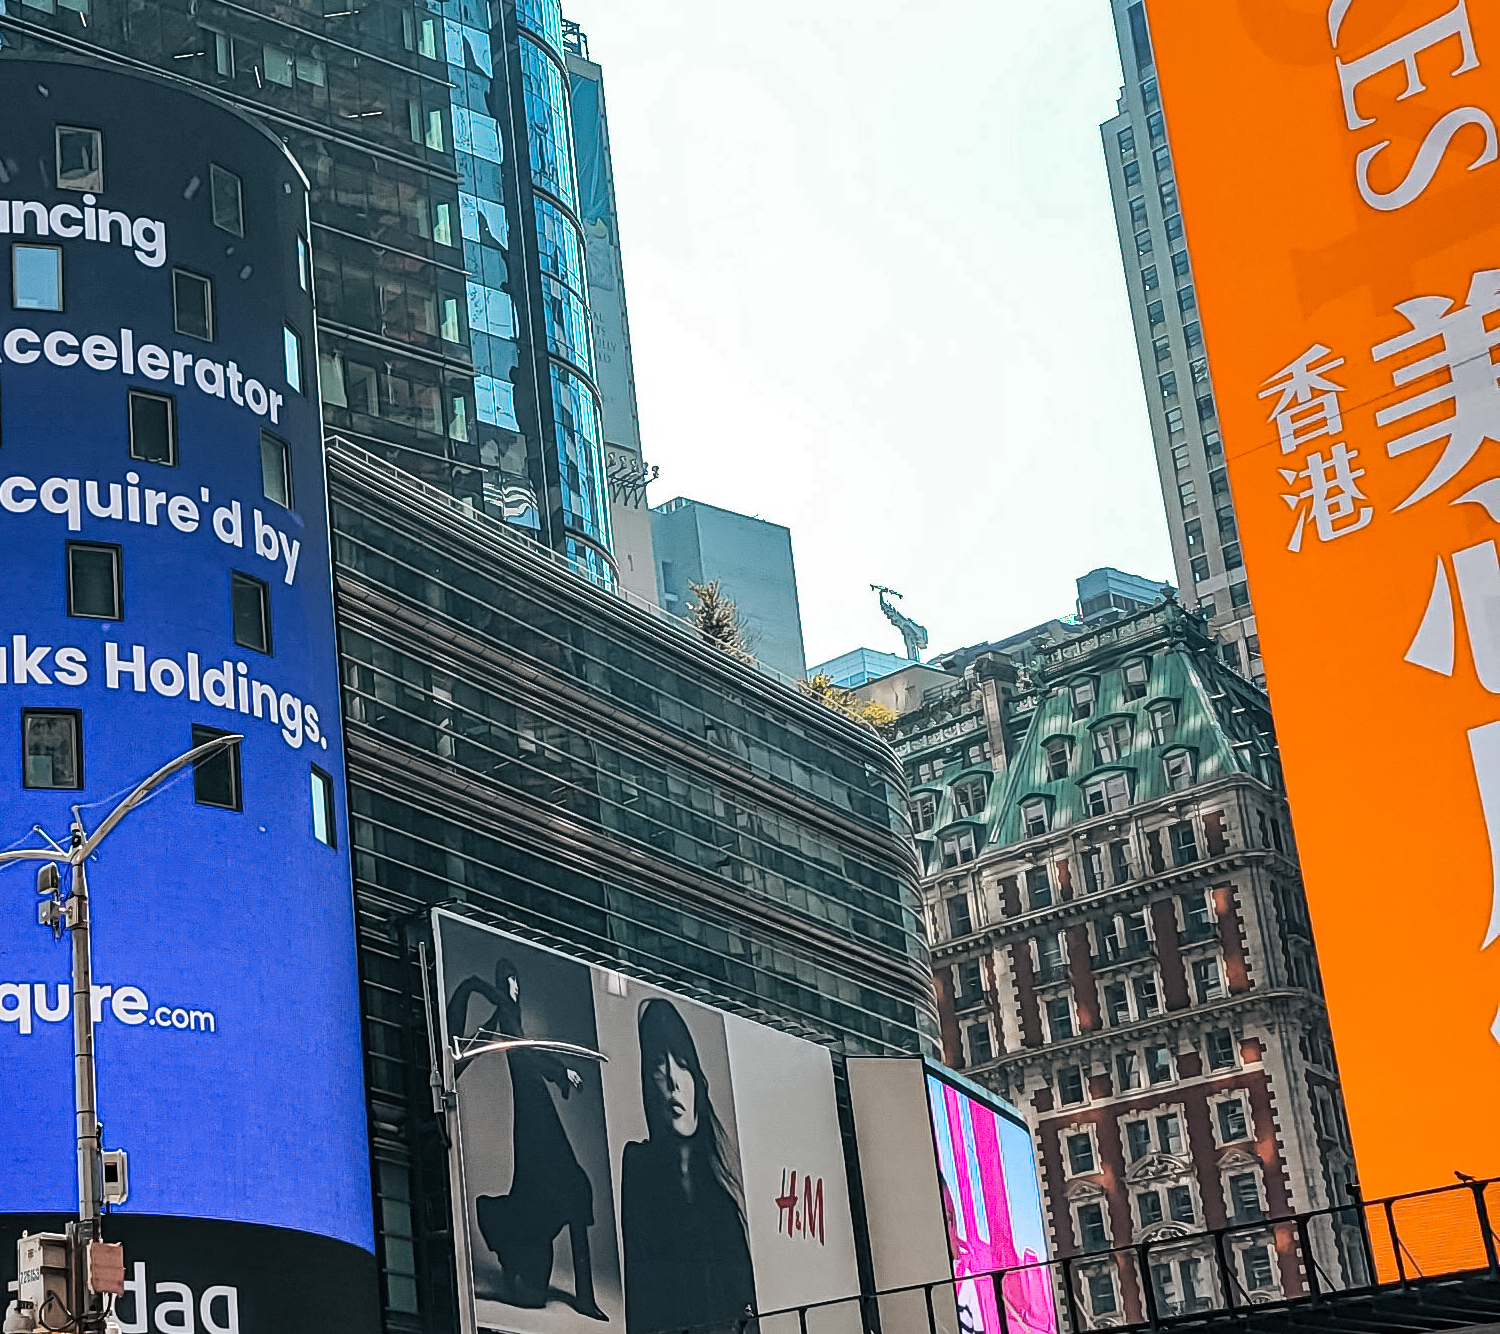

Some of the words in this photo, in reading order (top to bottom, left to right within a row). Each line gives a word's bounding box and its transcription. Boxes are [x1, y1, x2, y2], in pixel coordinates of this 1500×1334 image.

[1256, 342, 1375, 553] 香港
[253, 508, 301, 585] by
[104, 640, 330, 751] Holdings.
[775, 1167, 827, 1247] H&M
